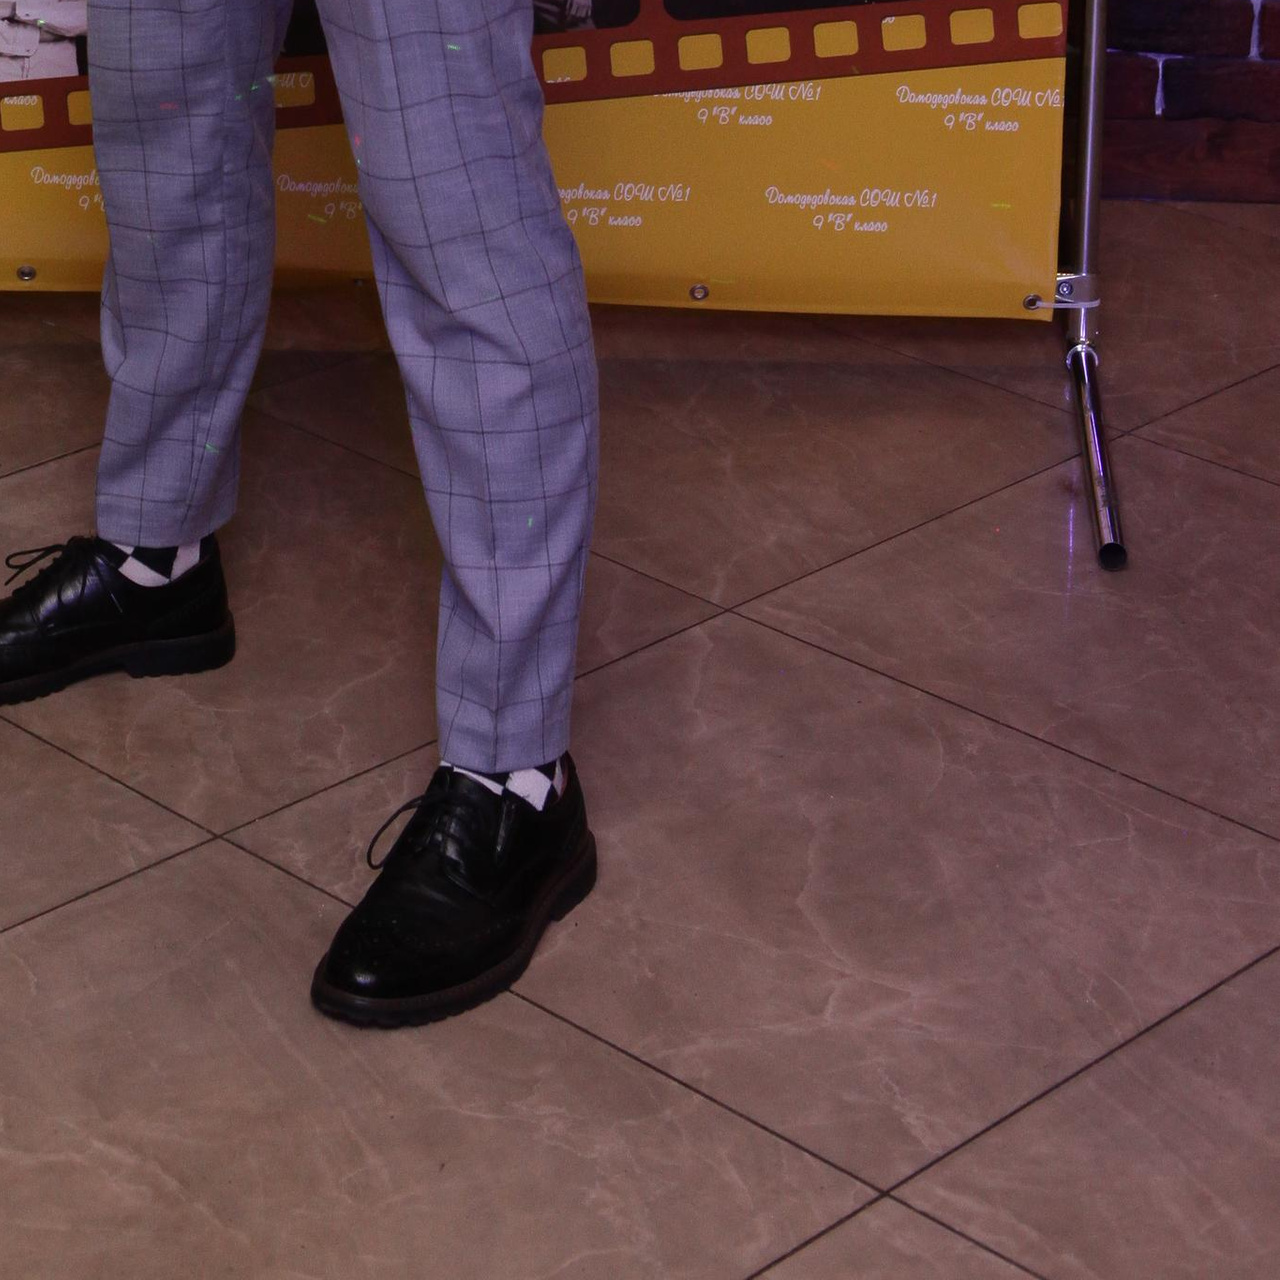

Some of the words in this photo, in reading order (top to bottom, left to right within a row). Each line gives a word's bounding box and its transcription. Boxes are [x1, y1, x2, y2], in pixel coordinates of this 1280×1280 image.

[788, 83, 821, 101] №1
[991, 87, 1031, 106] СОШ
[698, 109, 708, 124] 9
[944, 114, 954, 130] 9
[613, 183, 654, 201] СОШ
[658, 184, 690, 202] №1
[860, 189, 900, 207] СОШ
[905, 189, 937, 208] №1
[567, 210, 578, 225] 9
[814, 215, 823, 230] 9
